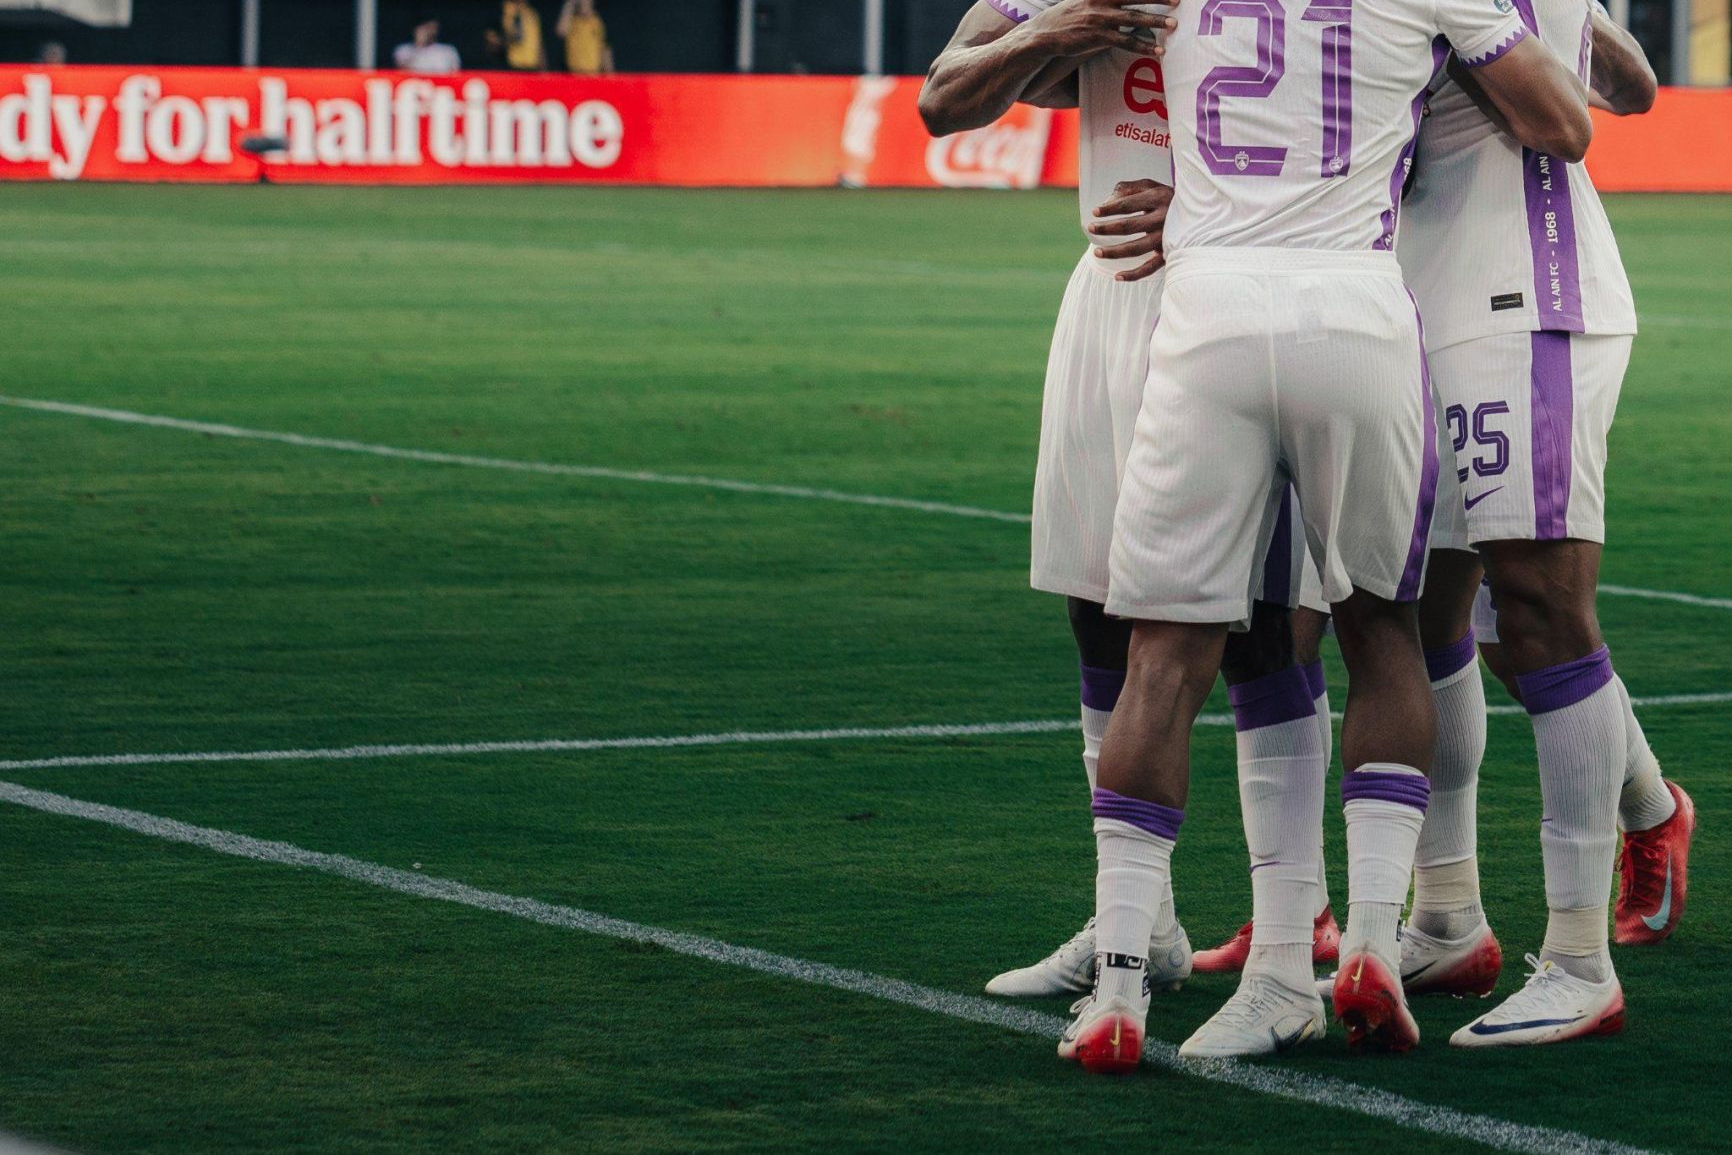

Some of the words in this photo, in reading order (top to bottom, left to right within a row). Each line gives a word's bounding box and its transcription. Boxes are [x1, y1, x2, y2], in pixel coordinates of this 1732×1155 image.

[0, 73, 107, 180] dy
[112, 74, 249, 164] for
[258, 76, 624, 168] halftime
[1115, 122, 1171, 149] etisalat
[1539, 156, 1550, 175] AIN
[1542, 176, 1553, 191] AL
[1544, 211, 1559, 243] 1968
[1549, 262, 1559, 276] FC
[1550, 279, 1561, 297] AIN
[1552, 298, 1563, 312] AL
[1446, 400, 1510, 484] 25
